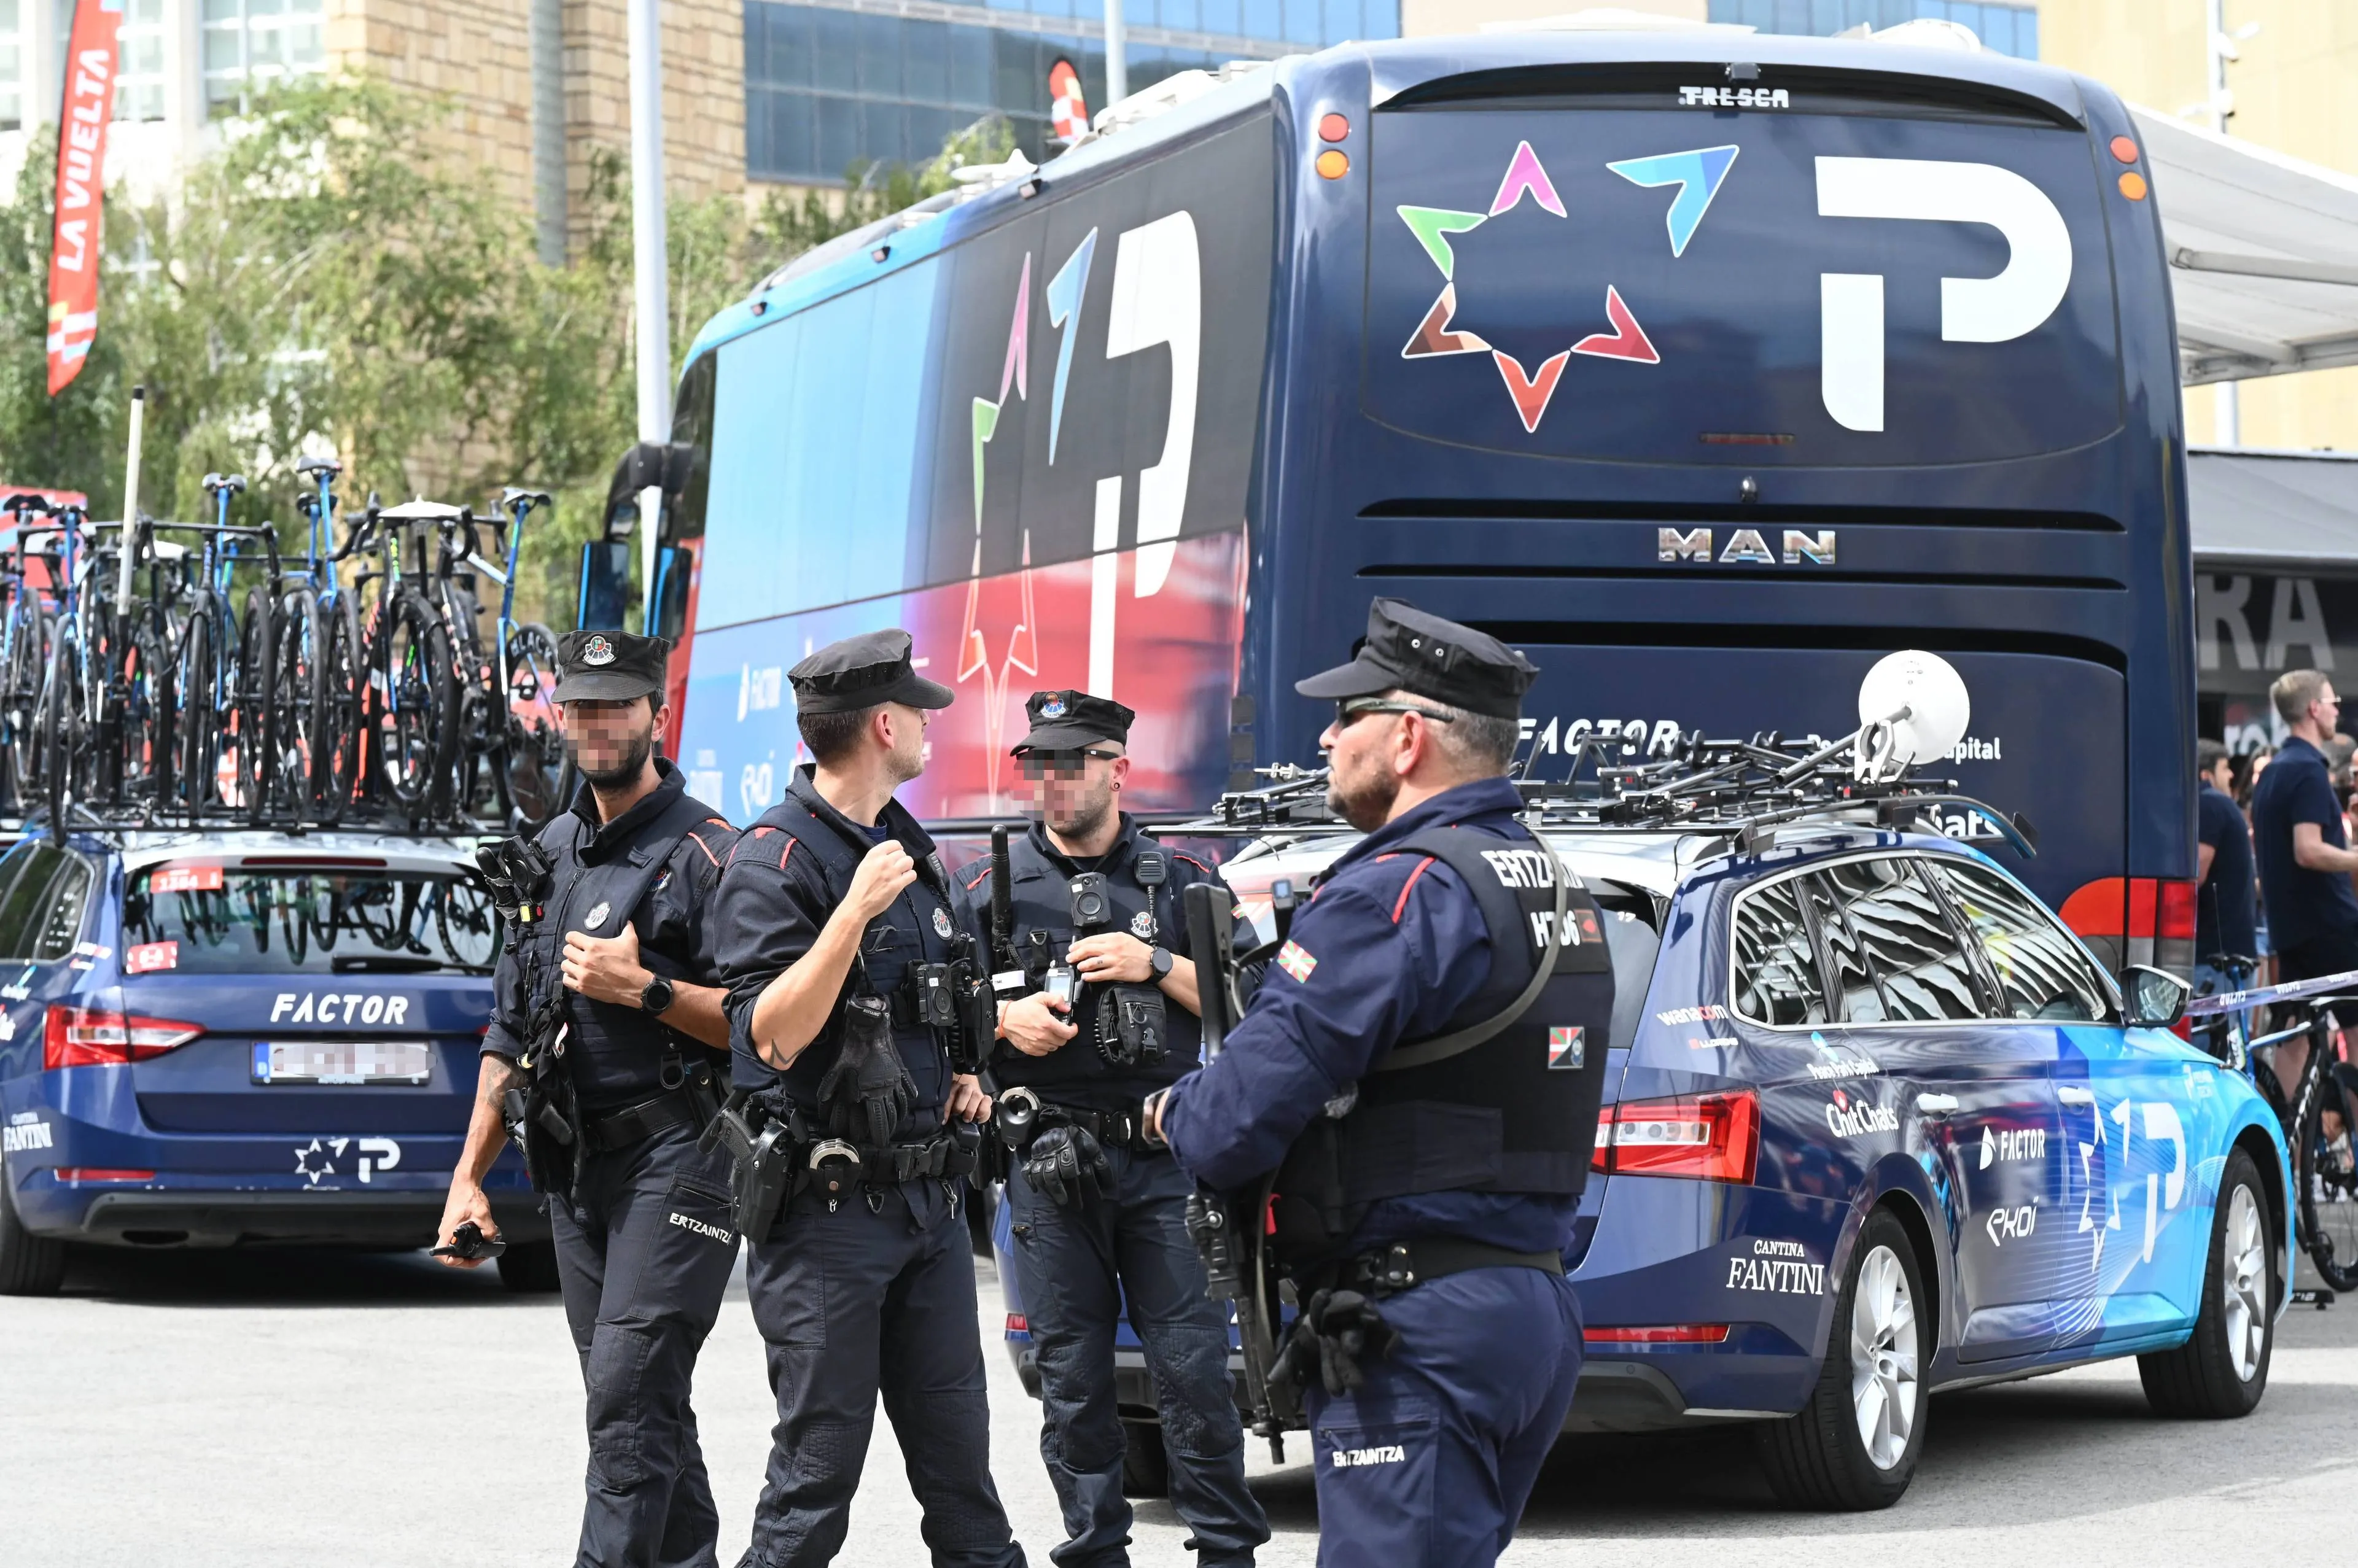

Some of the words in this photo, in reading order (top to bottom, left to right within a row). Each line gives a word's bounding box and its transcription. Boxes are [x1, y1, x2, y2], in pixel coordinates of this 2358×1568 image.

[1679, 85, 1789, 109] TRESCA
[64, 49, 110, 209] VUELTA
[58, 219, 87, 272] LA
[1657, 527, 1837, 565] MAN
[1519, 716, 1679, 755] FACTOR
[1944, 737, 2001, 765] apital
[270, 992, 408, 1025] FACTOR
[1657, 1004, 1729, 1026] wanacom
[2001, 1128, 2045, 1162] FACTOR
[1754, 1240, 1805, 1257] CANTINA
[1726, 1257, 1824, 1295] FANTINI
